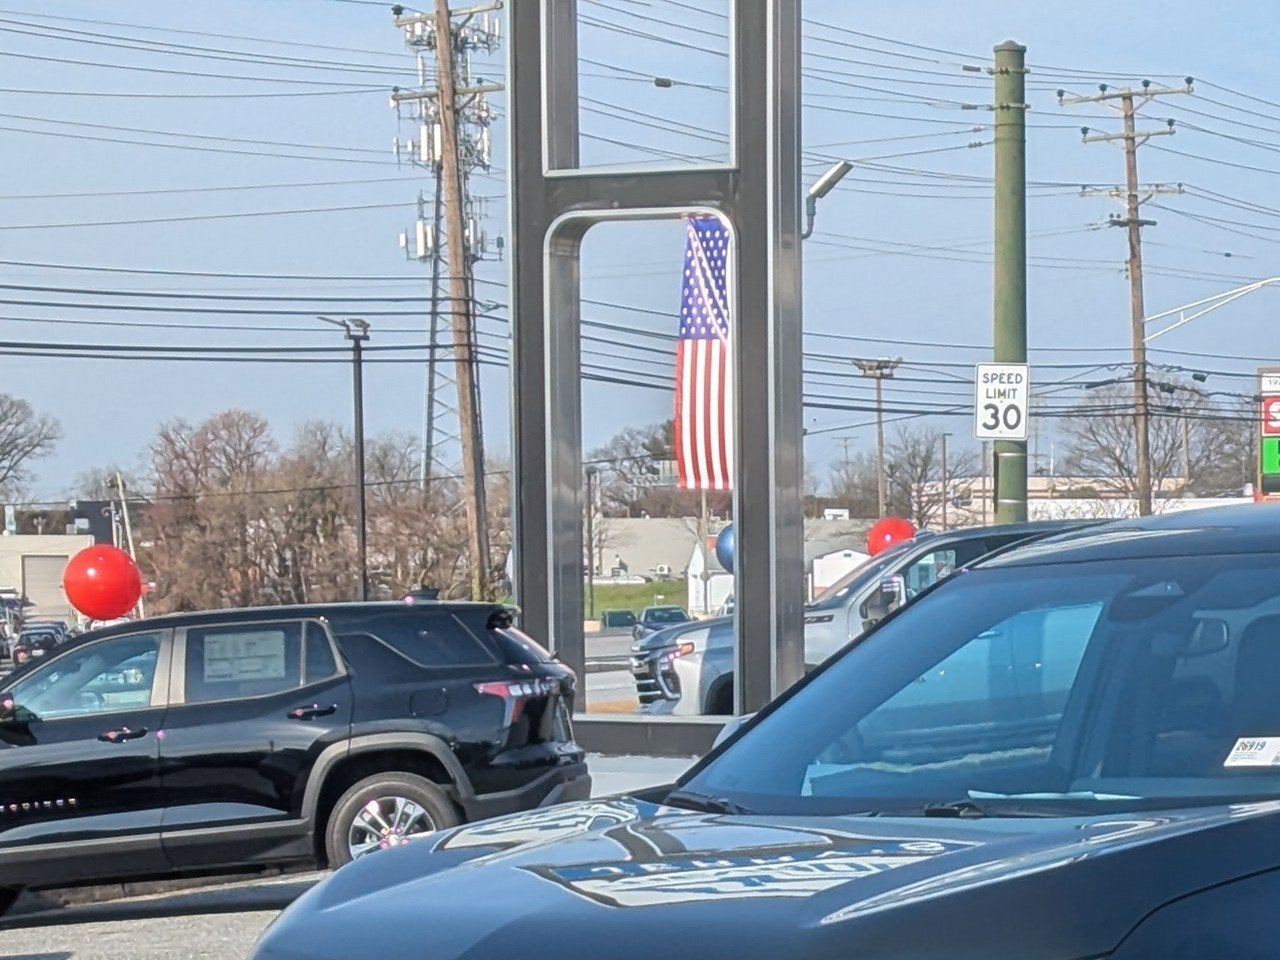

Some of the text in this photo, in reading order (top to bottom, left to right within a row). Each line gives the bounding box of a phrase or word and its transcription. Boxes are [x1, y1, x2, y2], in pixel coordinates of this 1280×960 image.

[982, 372, 1023, 384] SPEED
[986, 388, 1018, 399] LIMIT
[982, 403, 1022, 430] 30
